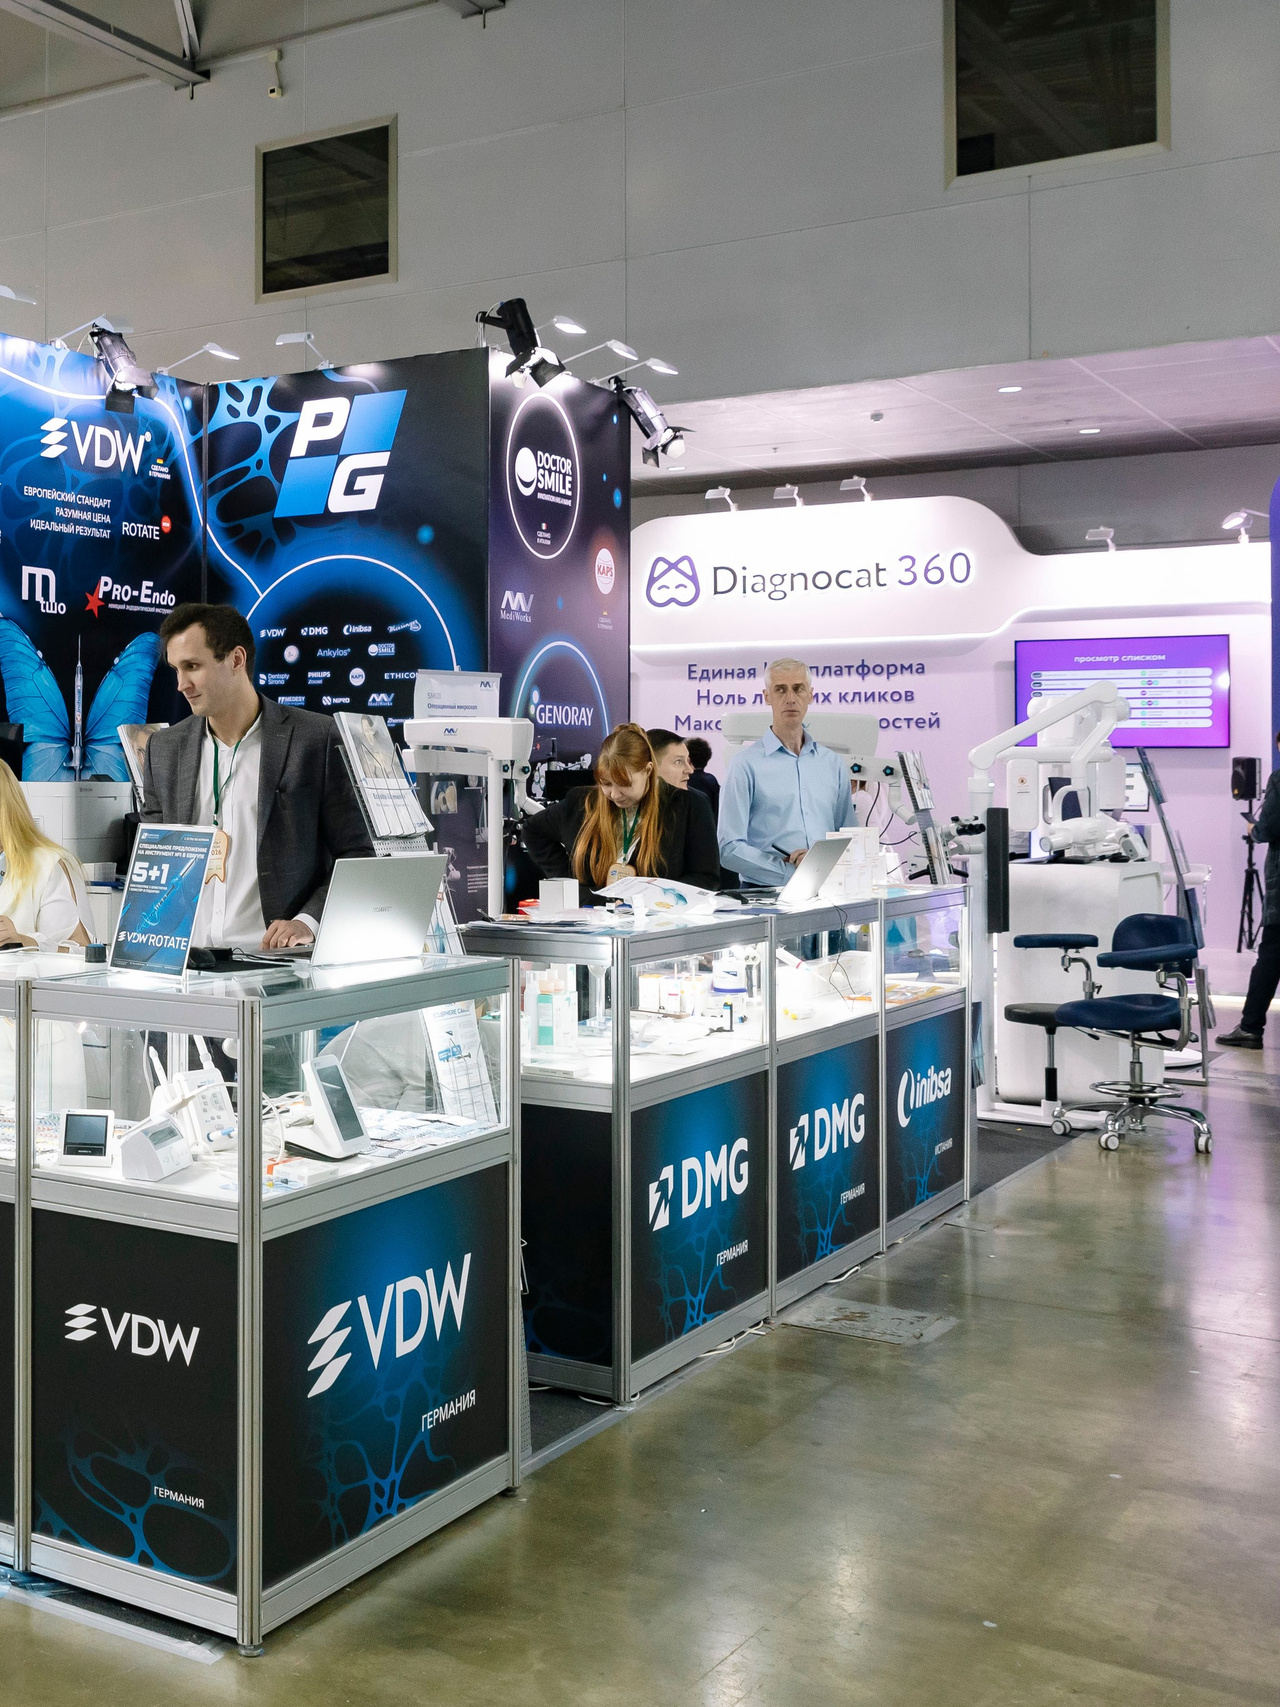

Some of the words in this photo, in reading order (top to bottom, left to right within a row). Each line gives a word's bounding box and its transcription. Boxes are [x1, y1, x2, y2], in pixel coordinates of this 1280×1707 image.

[537, 451, 572, 476] DOCTOR
[537, 469, 572, 496] SMILE
[24, 486, 76, 503] ЕВРОПЕЙСКИЙ
[76, 494, 111, 509] СТАНДАРТ
[55, 507, 92, 521] РАЗУМНАЯ
[92, 512, 111, 524] ЦЕНА
[30, 519, 74, 534] ИДЕАЛЬНЫЙ
[75, 524, 111, 539] РЕЗУЛЬТАТ
[122, 521, 160, 540] ROTATE
[597, 564, 613, 578] KAPS
[712, 562, 888, 601] Diagnocat
[897, 552, 972, 587] 360
[500, 609, 532, 623] MediWorks
[308, 627, 328, 635] DMG
[1074, 656, 1119, 664] просмотр
[1121, 654, 1166, 662] списком
[687, 664, 757, 681] Единая
[697, 689, 746, 706] Ноль
[838, 690, 915, 704] кликов
[536, 704, 593, 726] GENORAY
[131, 861, 170, 884] 5+1
[148, 934, 188, 950] ROTATE
[915, 1066, 952, 1109] inibsa
[814, 1093, 865, 1161] DMG
[935, 1137, 953, 1156] ИСПАНИЯ
[681, 1137, 749, 1219] DMG
[840, 1183, 865, 1205] ГЕРМАНИЯ
[716, 1239, 749, 1267] ГЕРМАНИЯ
[357, 1252, 472, 1370] VDW
[101, 1307, 200, 1366] VDW
[422, 1389, 476, 1432] ГЕРМАНИЯ
[154, 1485, 205, 1509] ГЕРМАНИЯ
